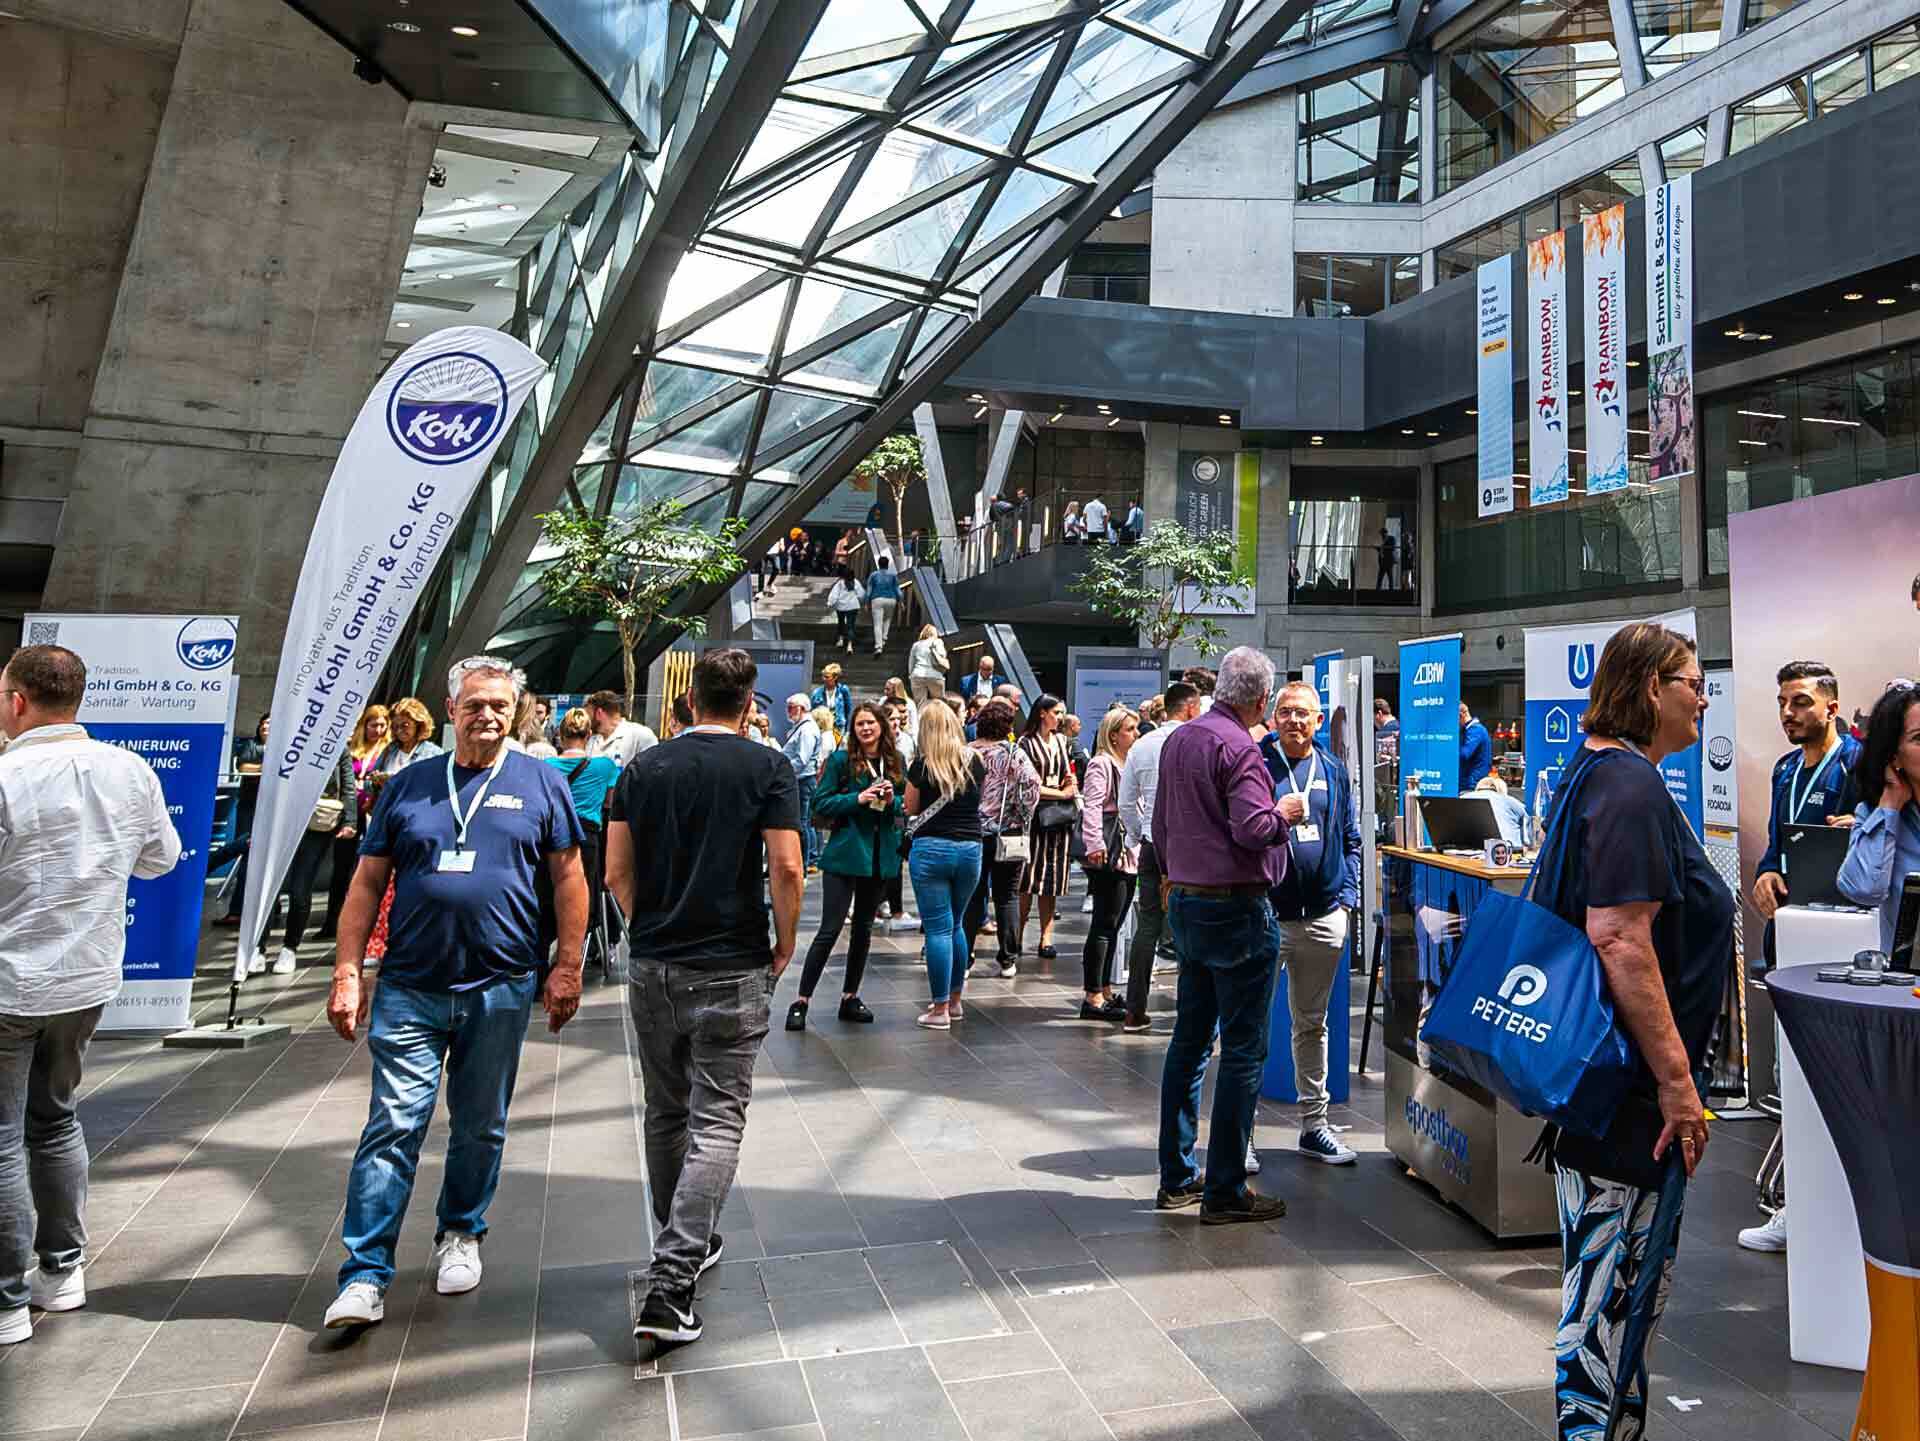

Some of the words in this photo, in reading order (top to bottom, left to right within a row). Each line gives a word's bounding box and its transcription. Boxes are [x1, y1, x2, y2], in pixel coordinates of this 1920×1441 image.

[1655, 187, 1665, 247] Scalzo
[1655, 254, 1665, 267] &
[1552, 293, 1560, 388] SANIERUNGEN
[1598, 277, 1610, 375] RAINBOW
[1609, 271, 1618, 371] SANIERUNGEN
[1655, 270, 1665, 346] Schmitt
[1541, 299, 1552, 392] RAINBOW
[406, 409, 482, 447] Kohl
[1200, 493, 1208, 522] GREEN
[322, 604, 338, 632] aus
[335, 543, 377, 606] Tradition.
[188, 644, 226, 663] Kohl
[279, 700, 324, 780] Konrad
[314, 641, 351, 697] Kohl
[343, 575, 386, 642] GmbH
[378, 553, 397, 571] &
[389, 518, 418, 550] Co.
[407, 481, 436, 515] KG
[311, 688, 363, 771] Heizung
[356, 609, 399, 675] Sanitär
[398, 511, 454, 591] Wartung
[85, 696, 129, 708] Sanitär
[141, 697, 196, 710] Wartung
[86, 680, 110, 692] ohl
[114, 680, 157, 692] GmbH
[161, 680, 171, 692] &
[175, 680, 196, 692] Co.
[201, 680, 222, 692] KG
[1472, 996, 1552, 1043] PETERS
